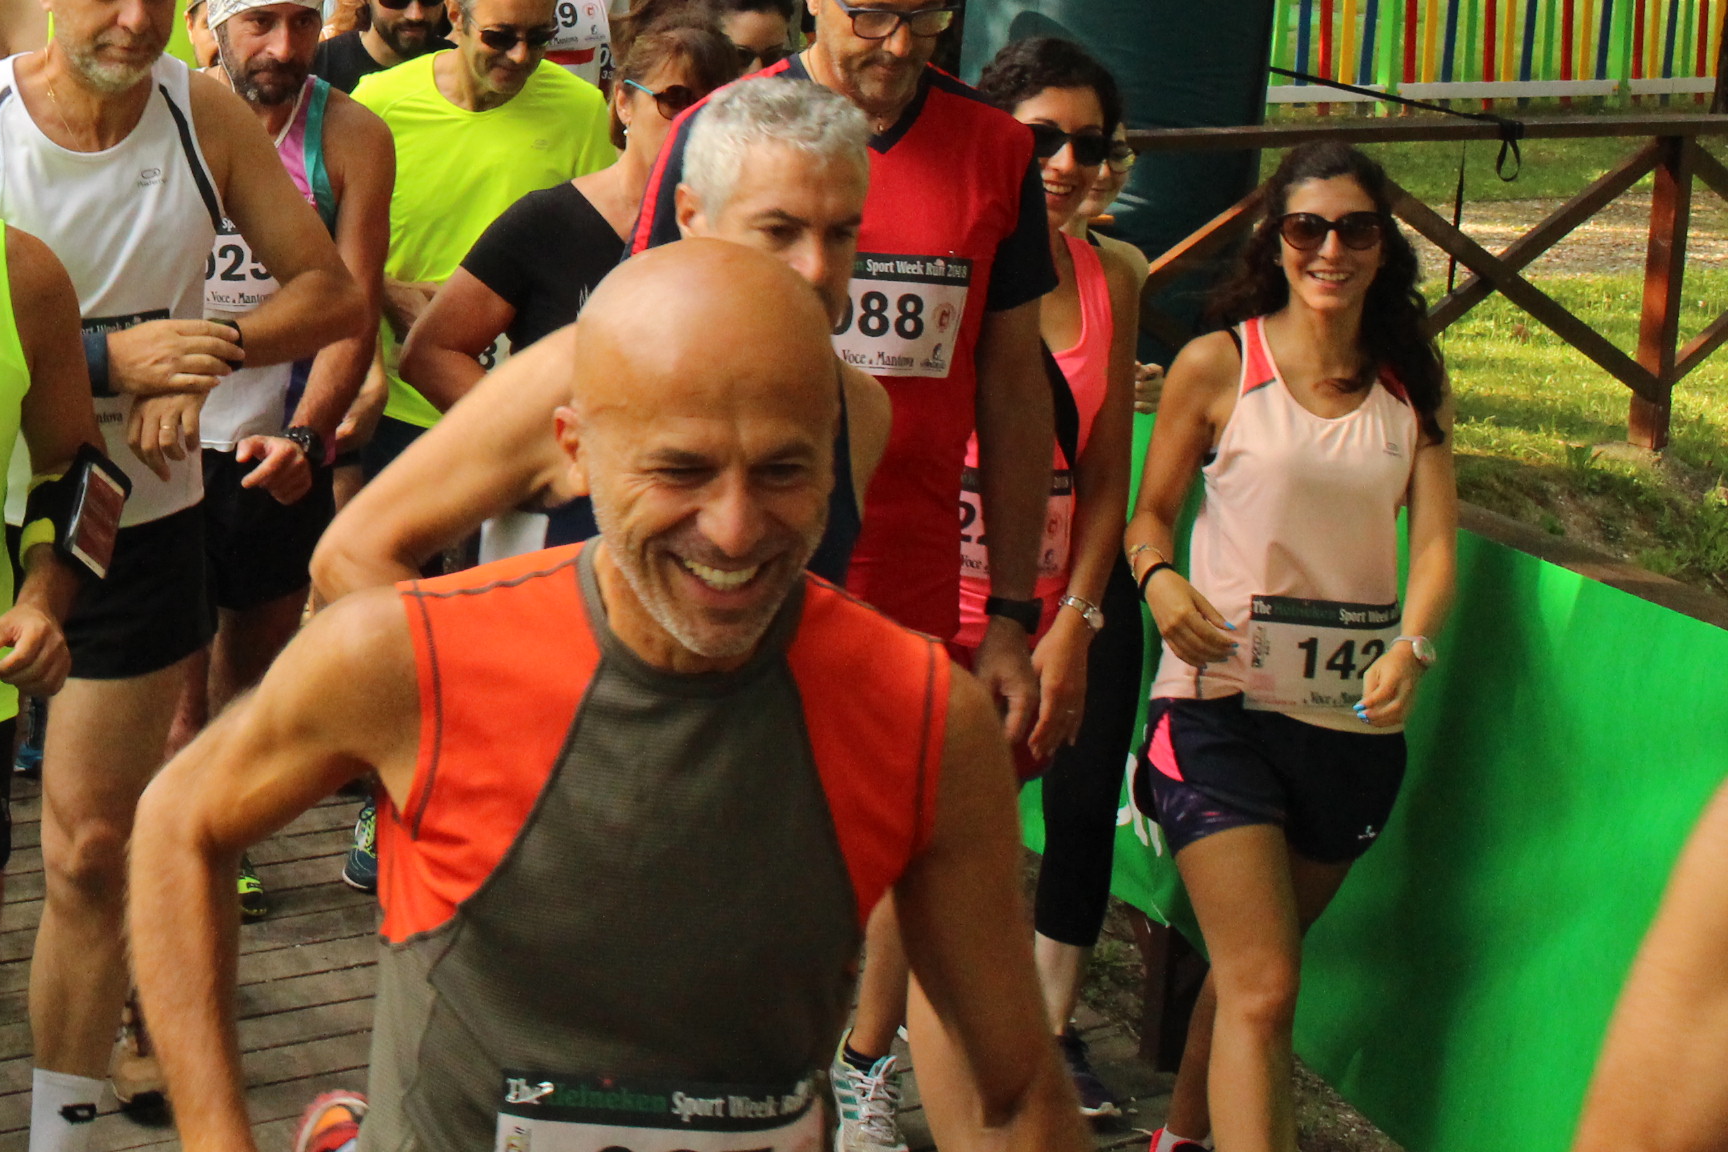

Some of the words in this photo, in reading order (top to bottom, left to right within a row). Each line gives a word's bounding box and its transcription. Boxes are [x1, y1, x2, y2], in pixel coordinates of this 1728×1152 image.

[866, 259, 894, 276] Sport
[896, 260, 924, 274] Week
[925, 262, 945, 277] Run
[947, 264, 968, 279] 2018
[211, 291, 230, 303] Voce
[238, 292, 268, 304] Manto
[843, 349, 866, 364] Voce
[96, 412, 122, 424] ntova
[1253, 600, 1272, 615] The
[1339, 608, 1367, 624] Sport
[1298, 637, 1385, 680] 142
[542, 1083, 668, 1114] Heineken
[671, 1091, 725, 1123] Sport
[728, 1094, 779, 1118] Week
